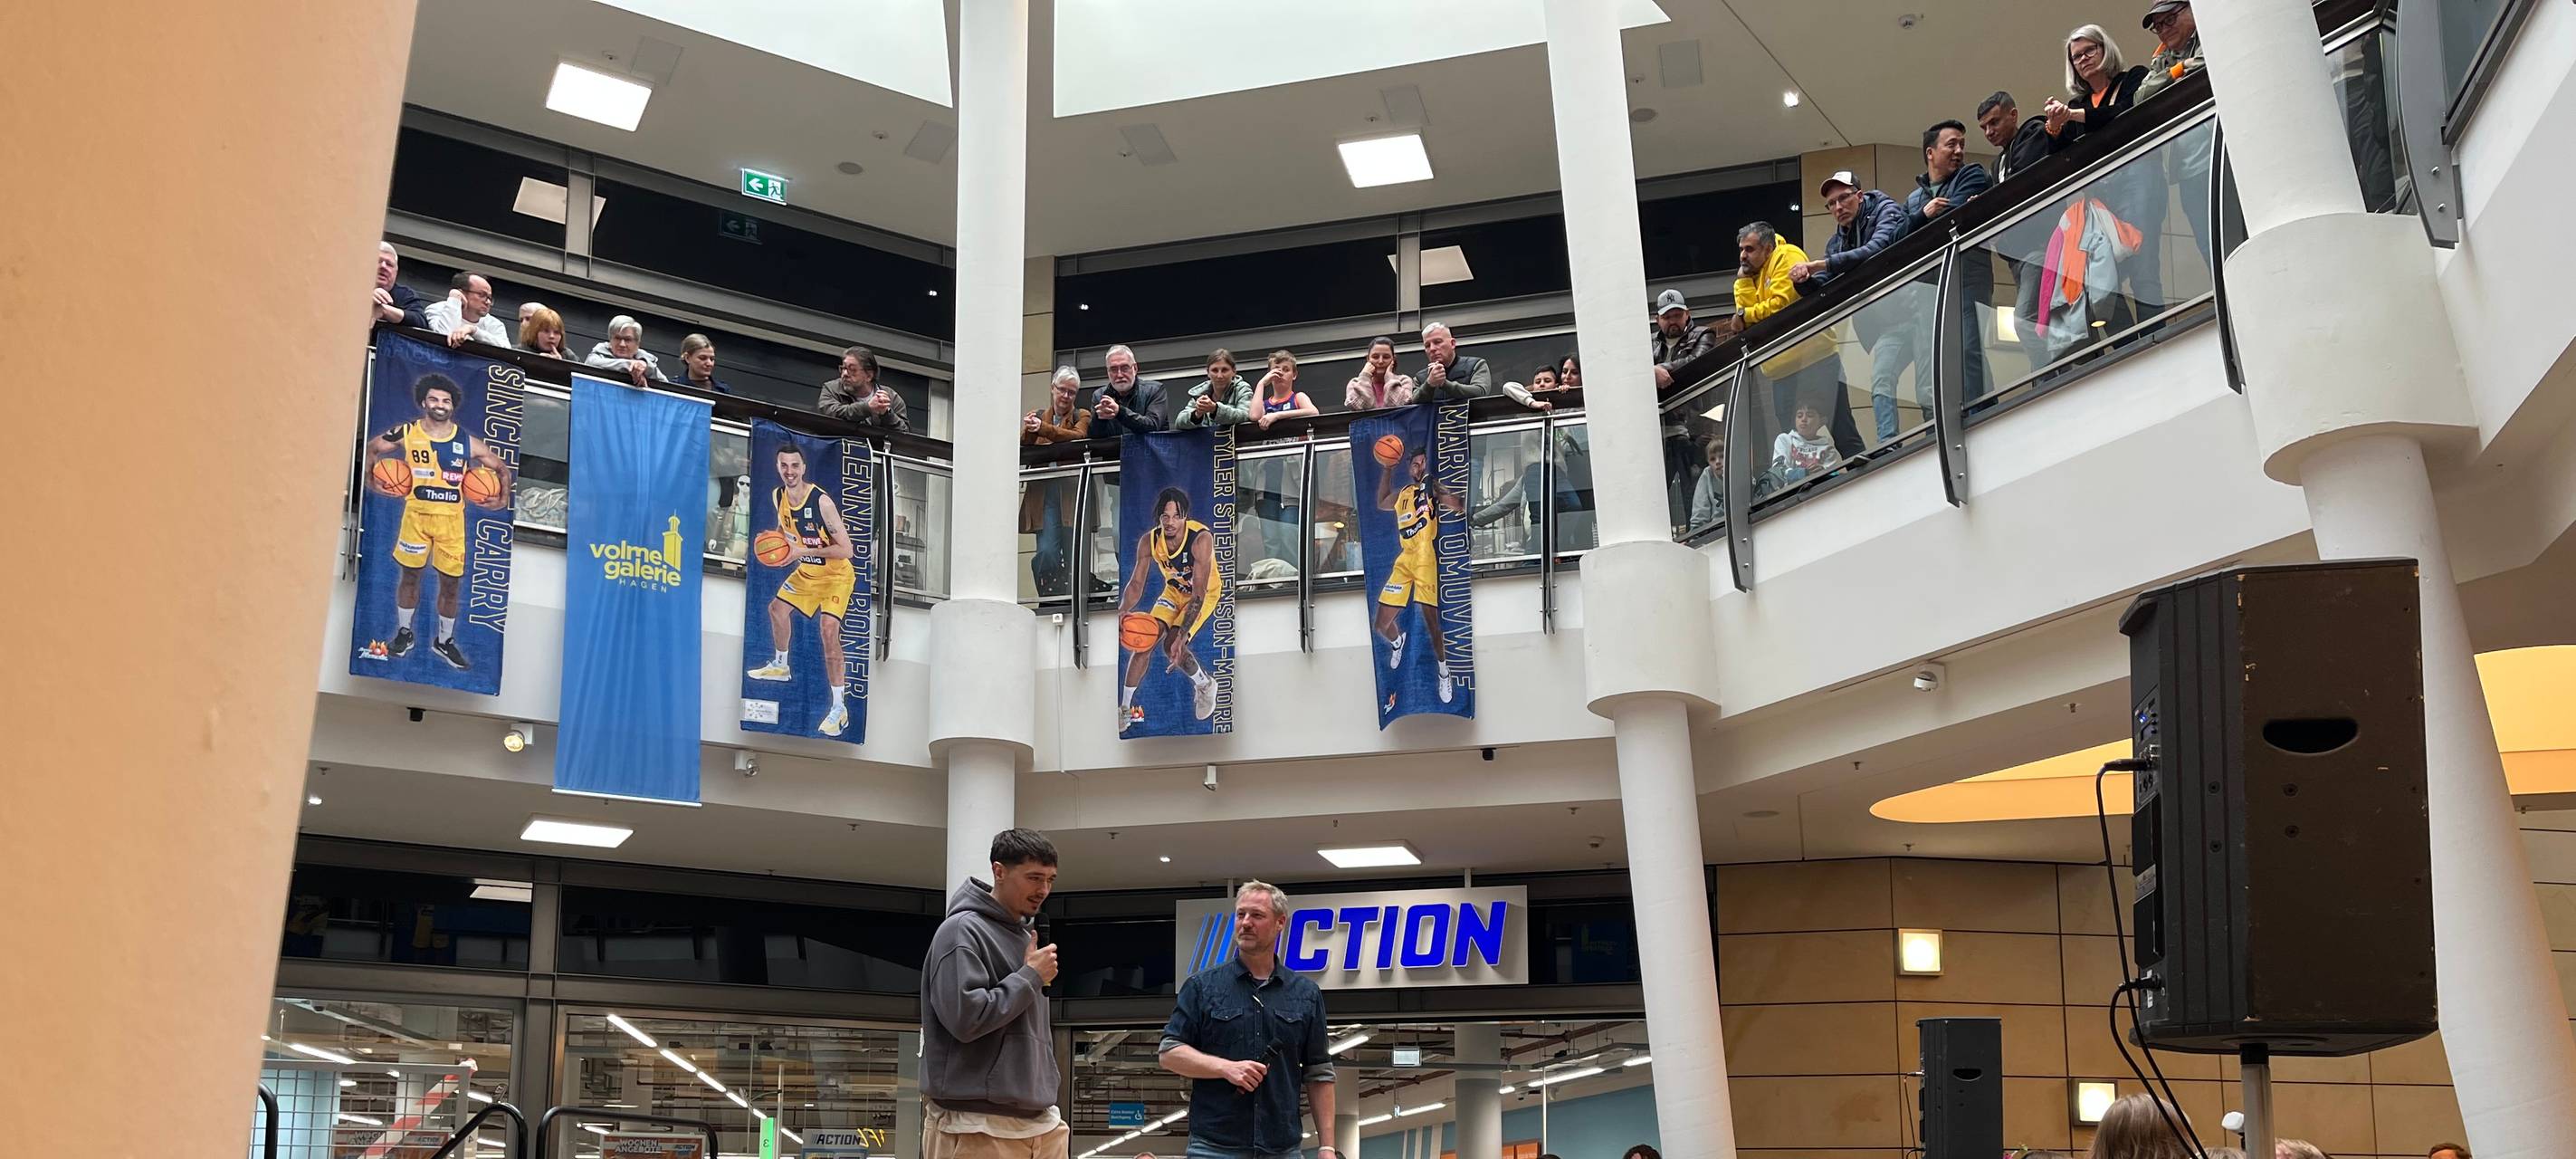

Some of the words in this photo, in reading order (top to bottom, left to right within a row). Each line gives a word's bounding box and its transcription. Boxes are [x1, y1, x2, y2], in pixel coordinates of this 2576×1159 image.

[482, 364, 526, 510] SINCE
[412, 449, 430, 464] 89
[1214, 427, 1236, 498] TYLER
[425, 489, 458, 502] Thalia
[802, 537, 822, 545] REWE
[589, 540, 663, 565] volme
[470, 518, 513, 634] CARRY
[604, 558, 682, 587] galerie
[619, 578, 667, 593] HAGEN
[1213, 503, 1236, 734] STEPHENSON-MOORE
[1235, 901, 1507, 972] CTION
[615, 1145, 663, 1154] ANGEBOTE
[619, 1139, 659, 1147] WOCHEN
[816, 1134, 861, 1145] ACTION
